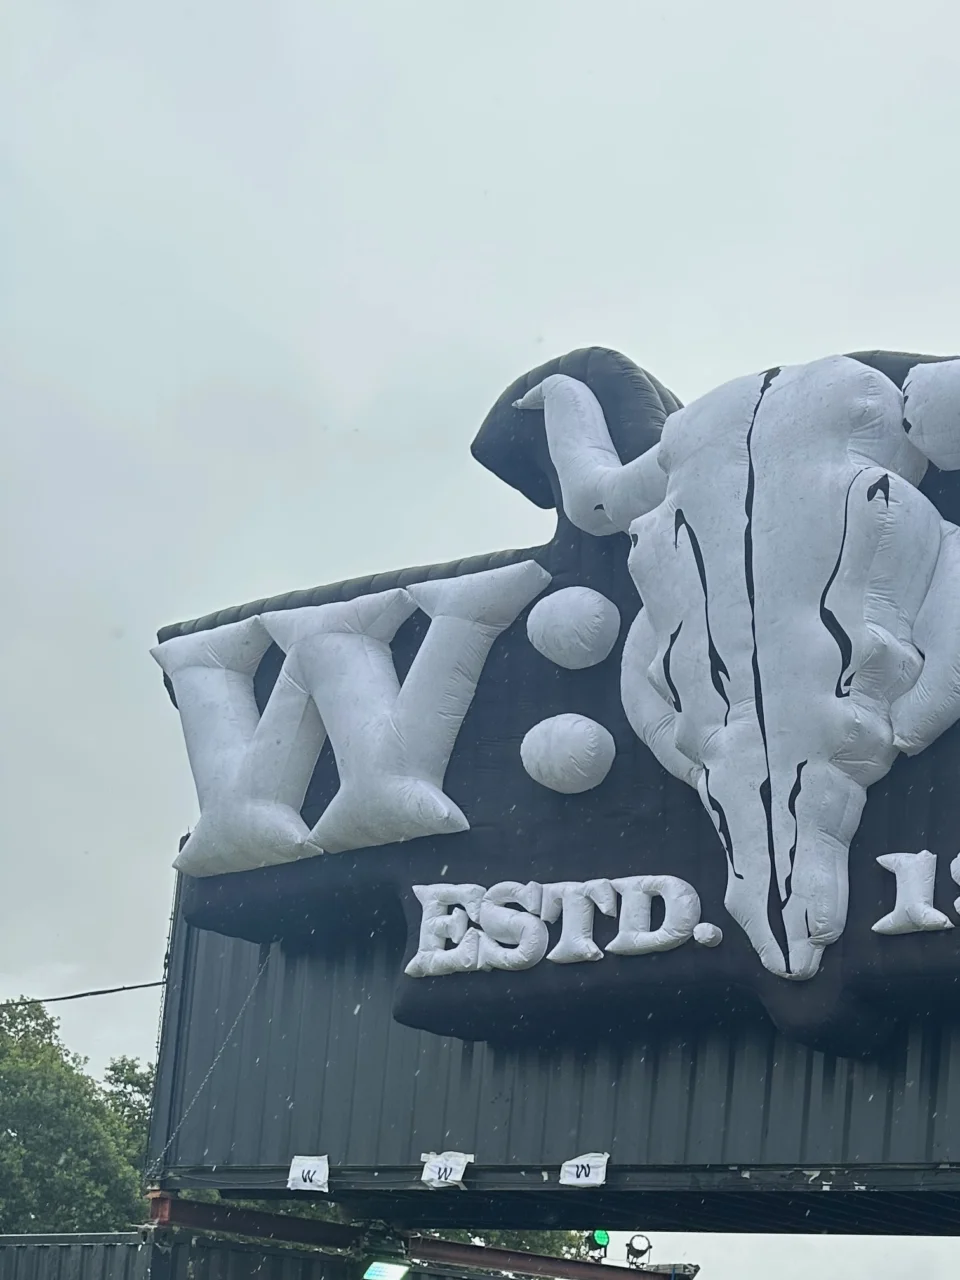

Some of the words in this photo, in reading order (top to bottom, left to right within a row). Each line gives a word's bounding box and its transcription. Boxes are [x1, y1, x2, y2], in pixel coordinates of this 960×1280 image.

[404, 874, 723, 978] ESTD.
[302, 1169, 316, 1183] W
[437, 1167, 453, 1181] W
[575, 1163, 591, 1179] W
